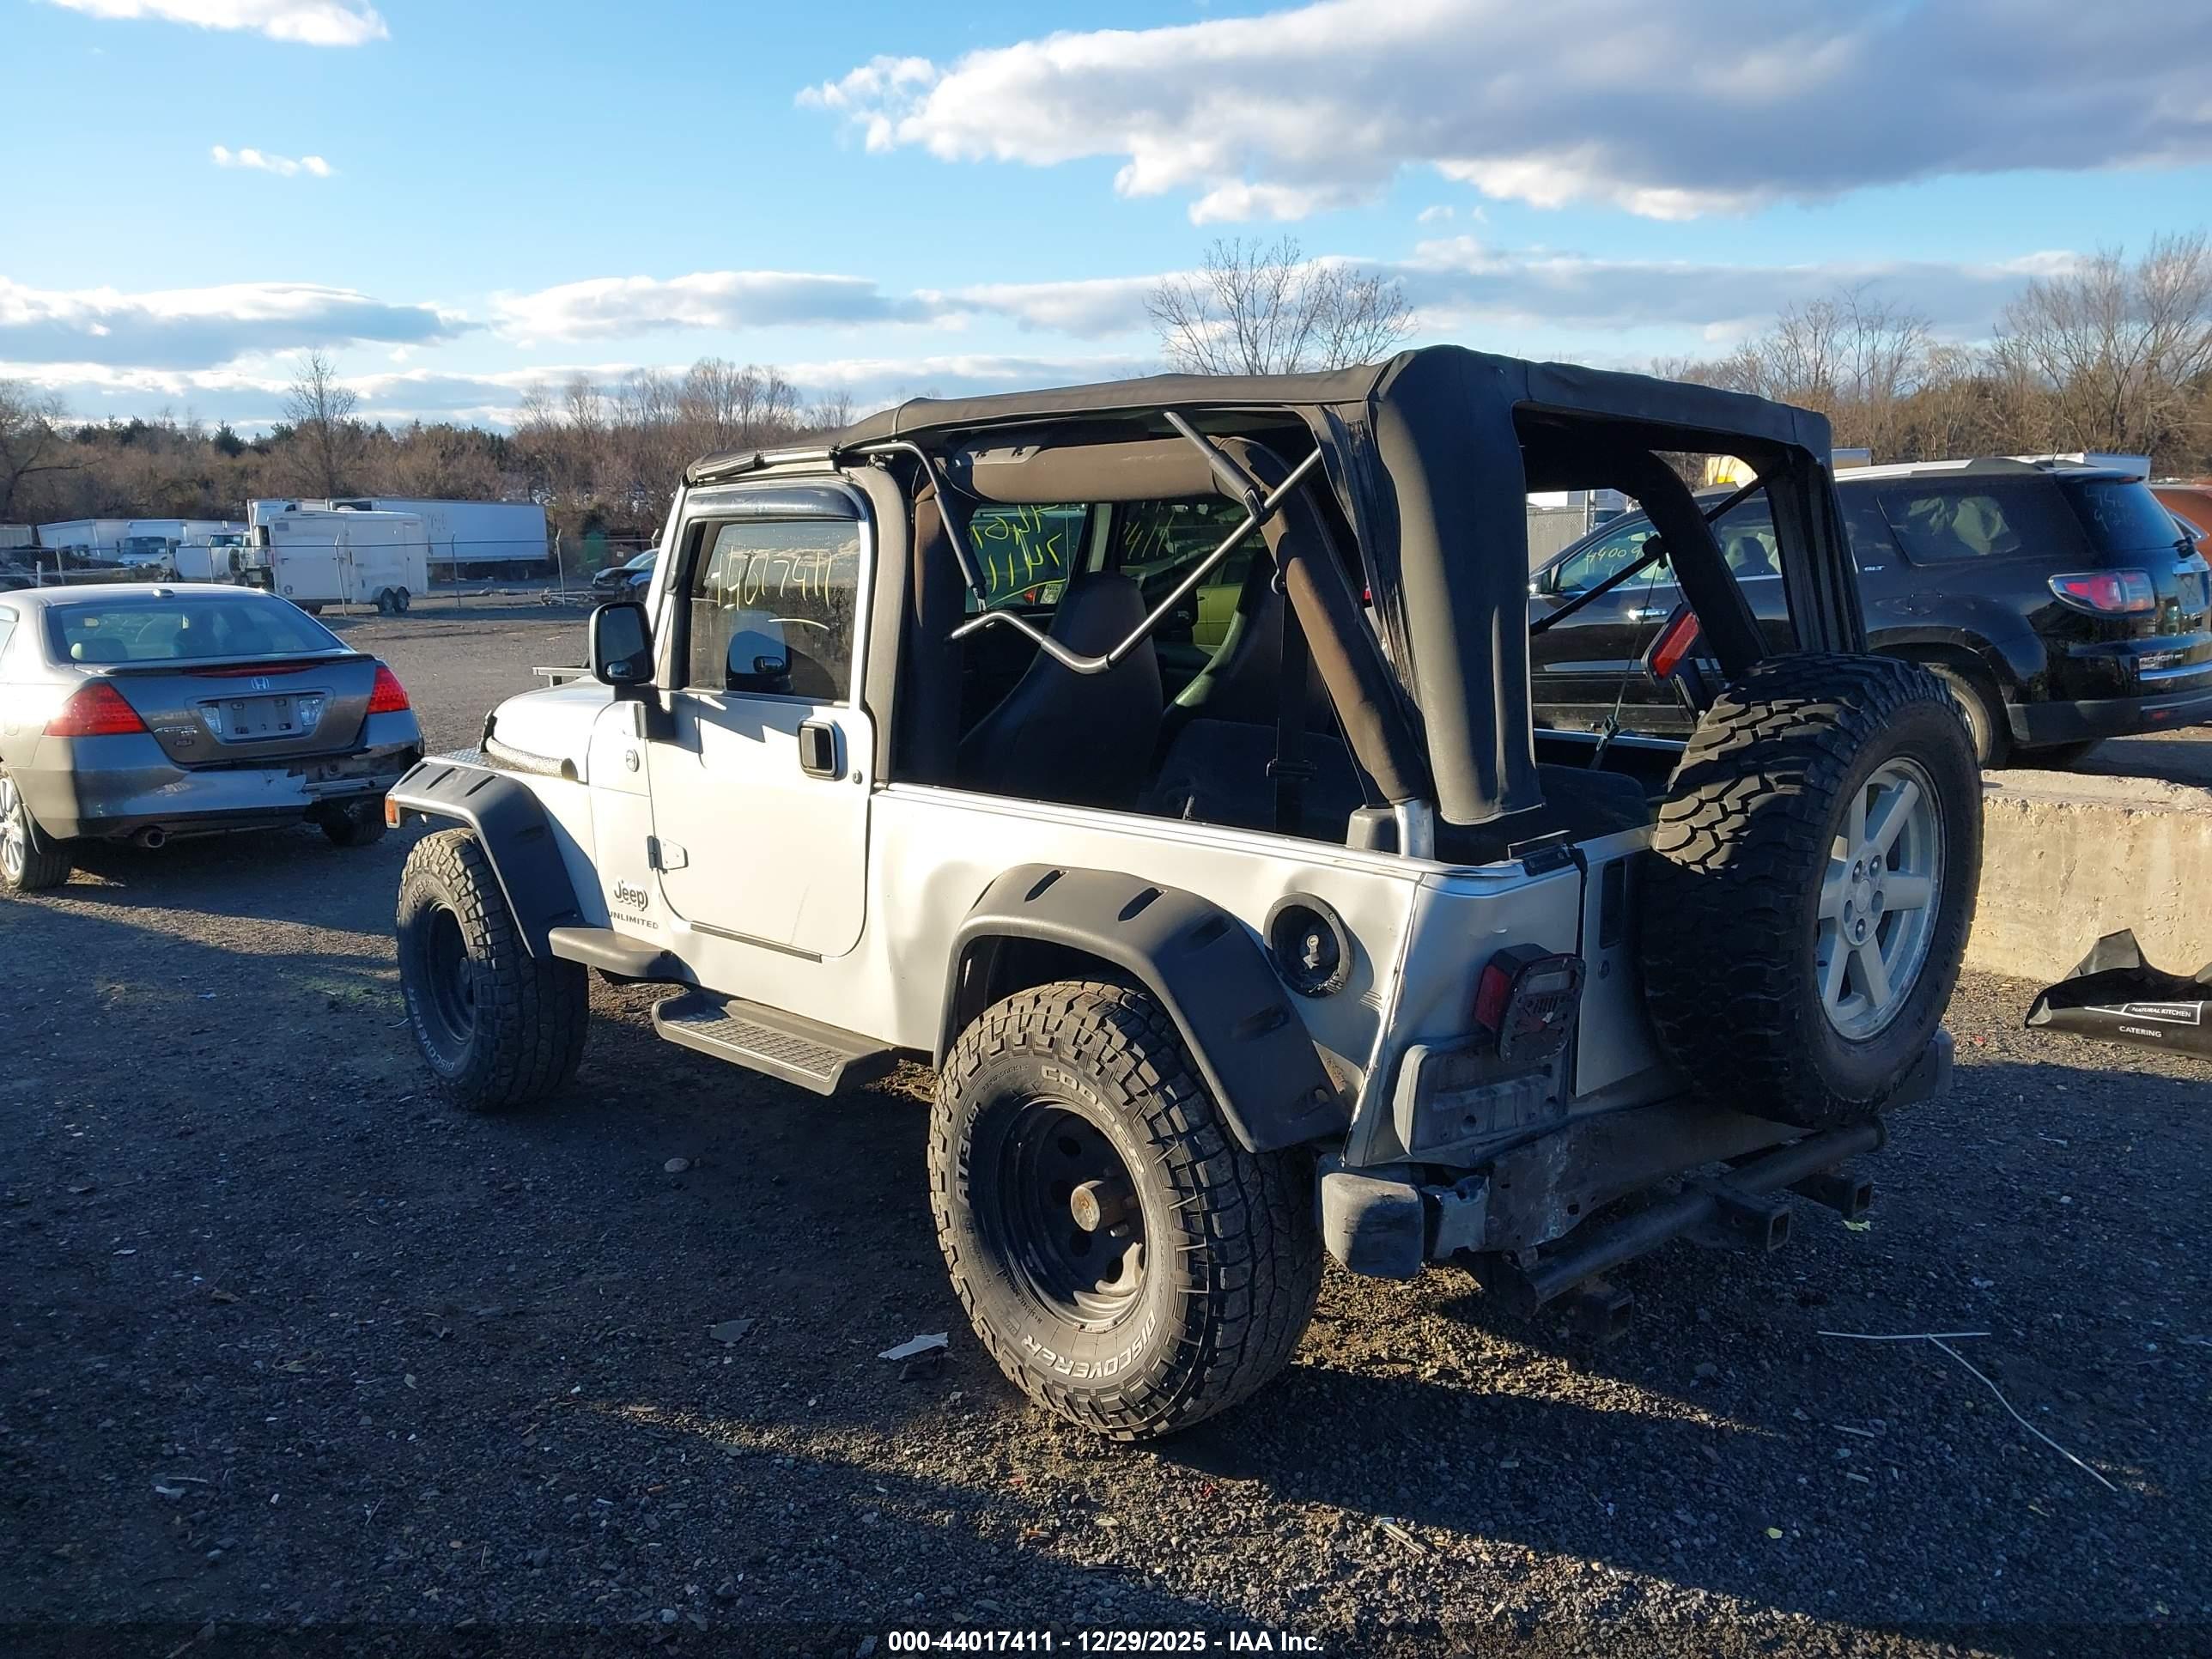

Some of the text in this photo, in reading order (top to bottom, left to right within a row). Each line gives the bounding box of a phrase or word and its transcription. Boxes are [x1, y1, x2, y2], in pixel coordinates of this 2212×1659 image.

[613, 878, 647, 910] Jeep
[608, 910, 659, 929] UNLIMITED
[2161, 1008, 2191, 1018] KITCHEN
[2118, 1025, 2162, 1037] CATERING
[1041, 1064, 1146, 1175] COOPER
[1020, 1310, 1157, 1380] DISCOVERER
